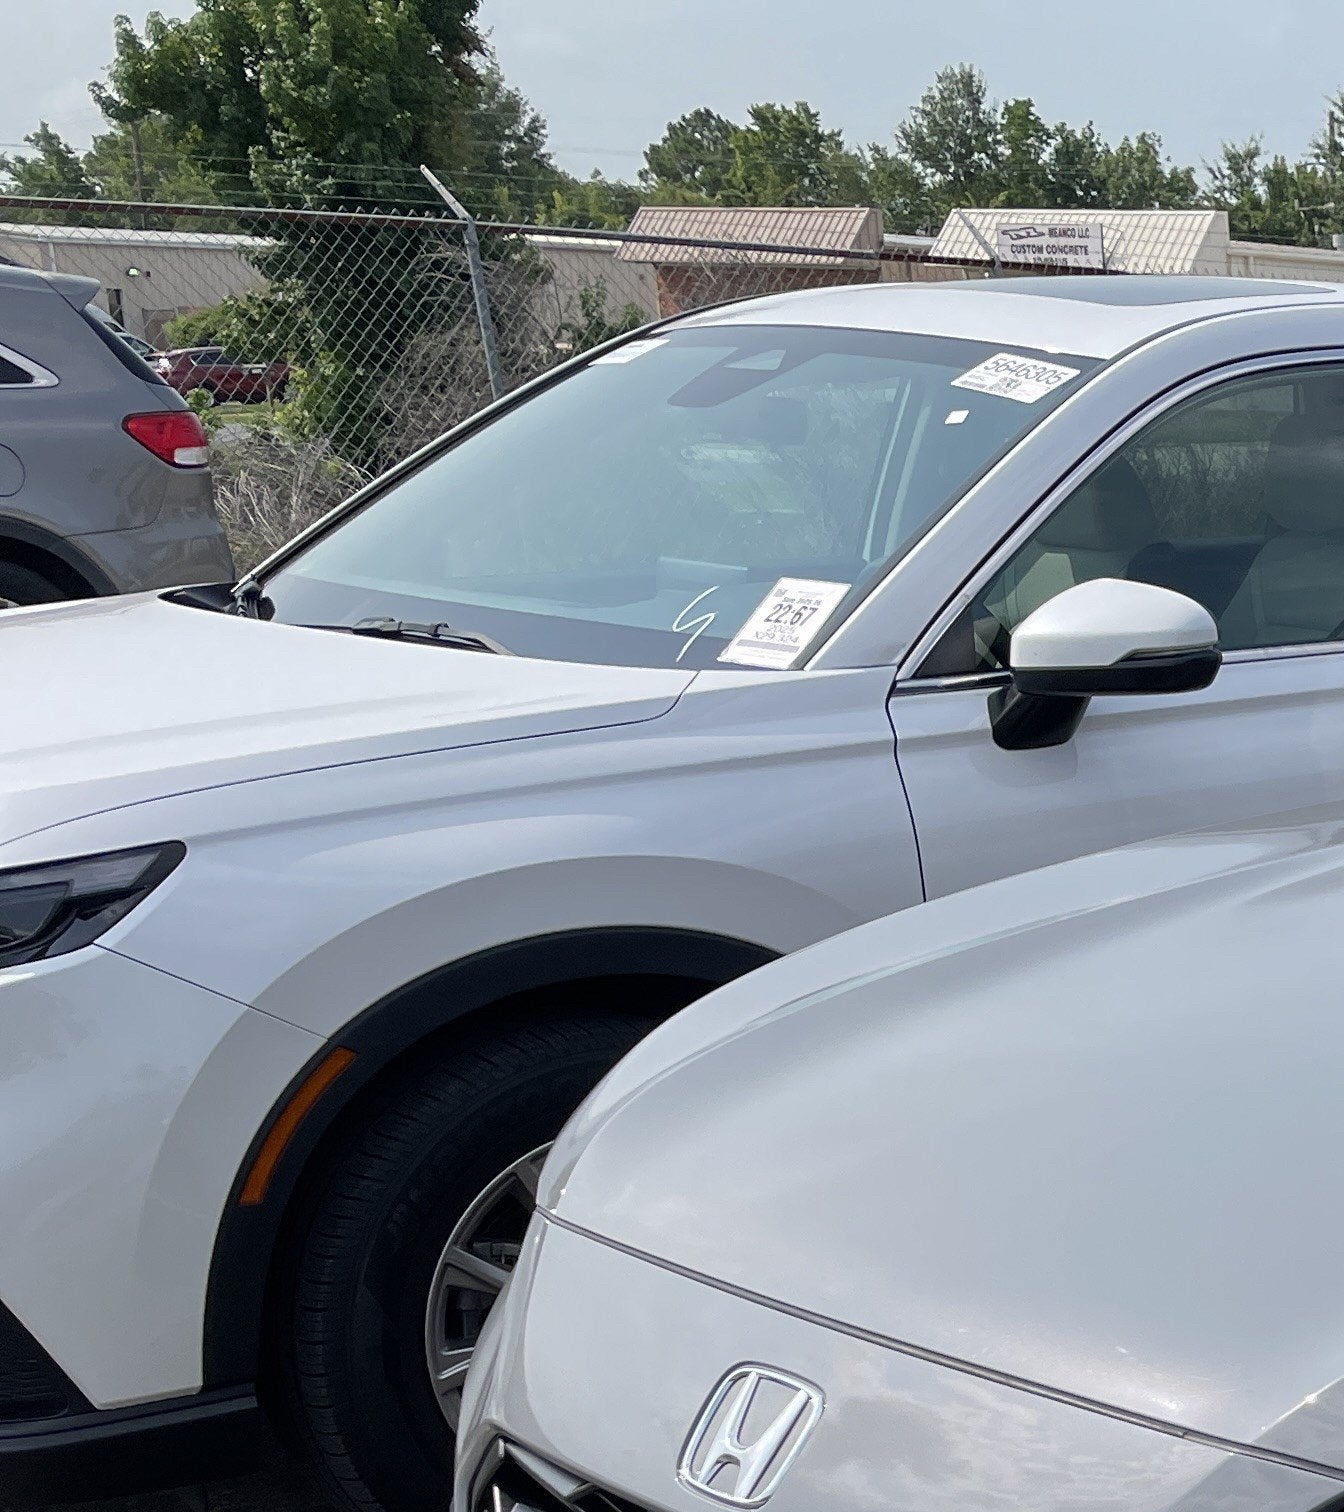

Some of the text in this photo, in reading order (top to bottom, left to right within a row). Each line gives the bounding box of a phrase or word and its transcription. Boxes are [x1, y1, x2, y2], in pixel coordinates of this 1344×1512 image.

[1078, 227, 1090, 239] LLC
[1010, 243, 1090, 256] CUSTOM CONCRETE
[763, 603, 819, 627] 22:67
